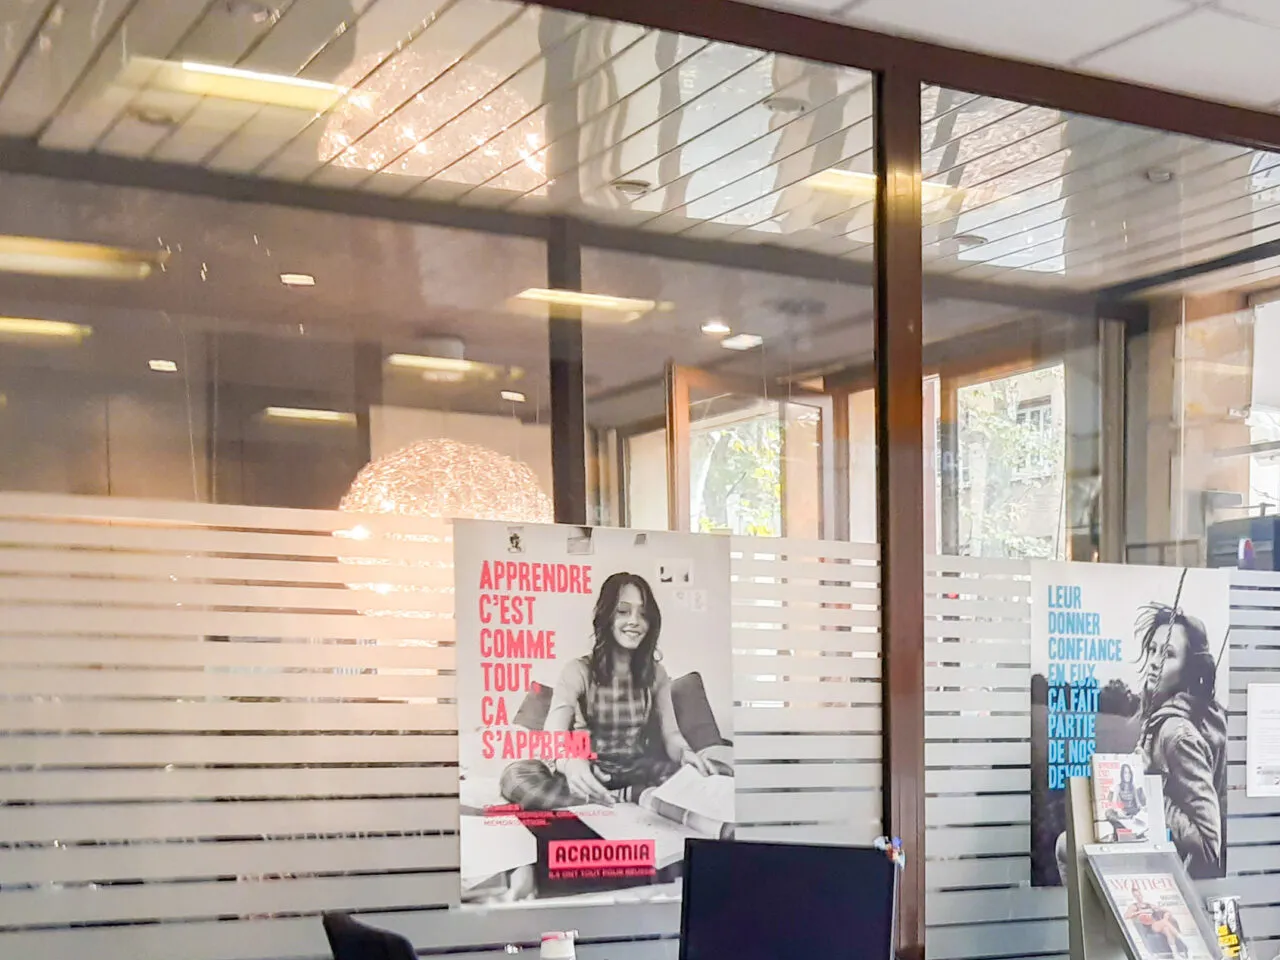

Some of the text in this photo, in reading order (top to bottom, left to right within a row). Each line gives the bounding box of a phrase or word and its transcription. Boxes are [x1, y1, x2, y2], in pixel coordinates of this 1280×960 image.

[480, 560, 592, 594] APPRENDRE
[480, 594, 536, 625] C'EST
[1048, 585, 1081, 609] LEUR
[1048, 611, 1100, 635] DONNER
[480, 628, 556, 659] COMME
[1048, 637, 1122, 662] CONFIANCE
[1048, 663, 1065, 687] EN
[481, 696, 508, 729] ÇA
[1070, 688, 1100, 713] FAIT
[1048, 714, 1096, 738] PARTIE
[482, 730, 598, 760] S'APPREND.
[1048, 740, 1096, 763] DE NOS
[556, 844, 650, 863] ACADOMIA
